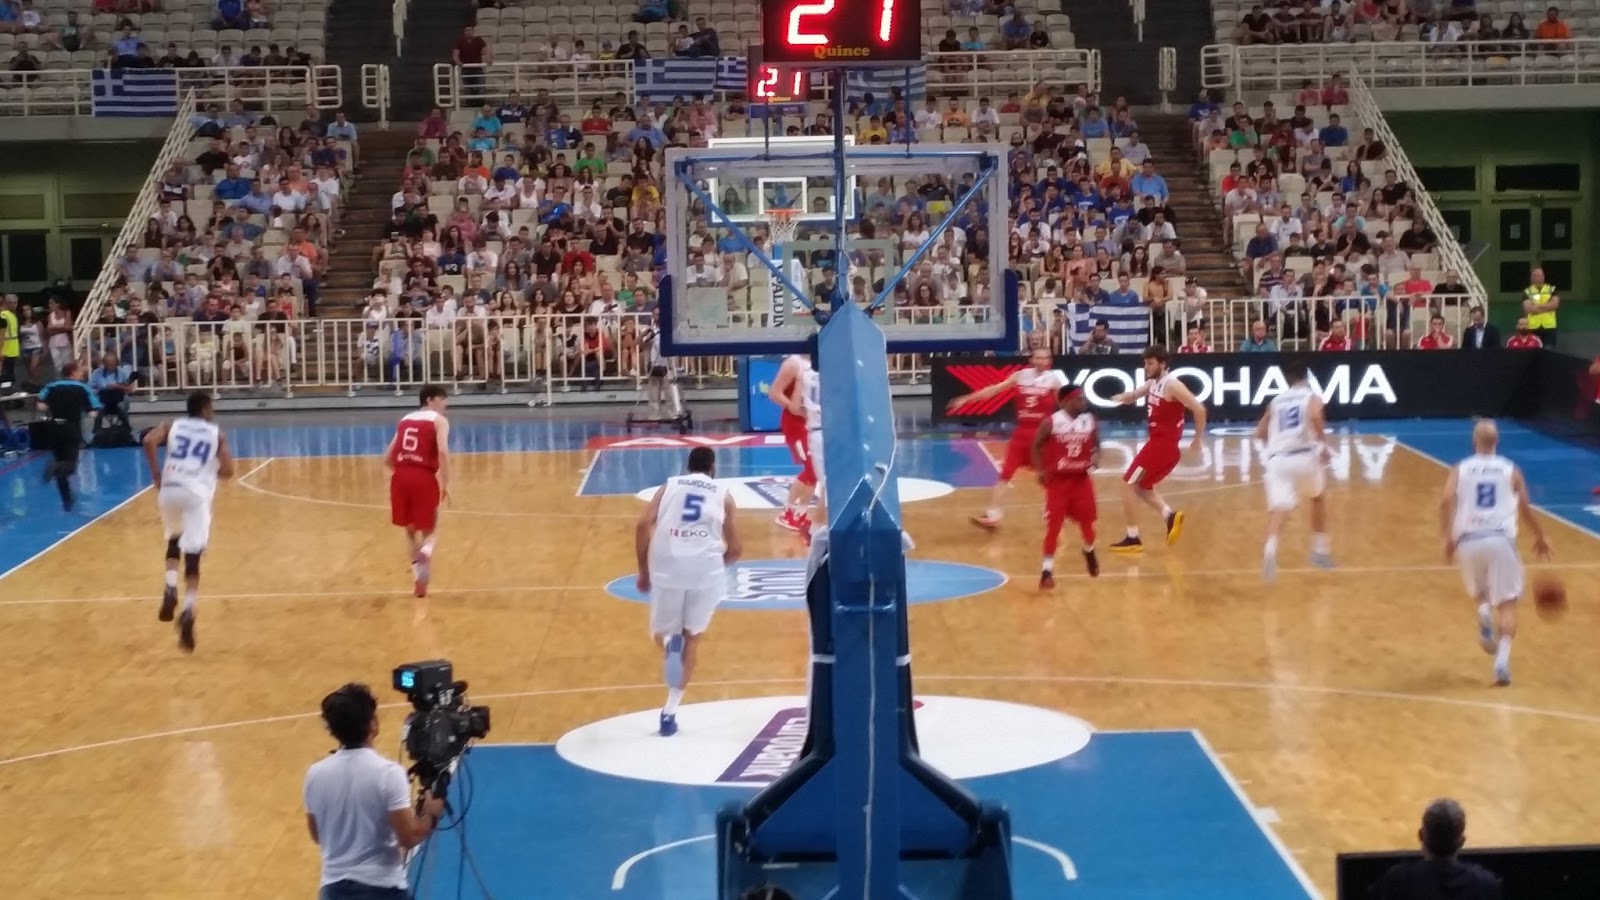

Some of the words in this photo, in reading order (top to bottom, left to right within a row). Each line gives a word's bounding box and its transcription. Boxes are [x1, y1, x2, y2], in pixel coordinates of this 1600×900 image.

[787, 0, 894, 44] 21
[814, 45, 870, 59] Quince
[757, 67, 801, 97] 21
[771, 265, 784, 327] PALDIN
[171, 435, 212, 466] 34
[402, 427, 419, 452] 6
[607, 435, 787, 446] AVI
[681, 493, 706, 522] 5
[1476, 482, 1497, 508] 8
[681, 529, 708, 538] EKO
